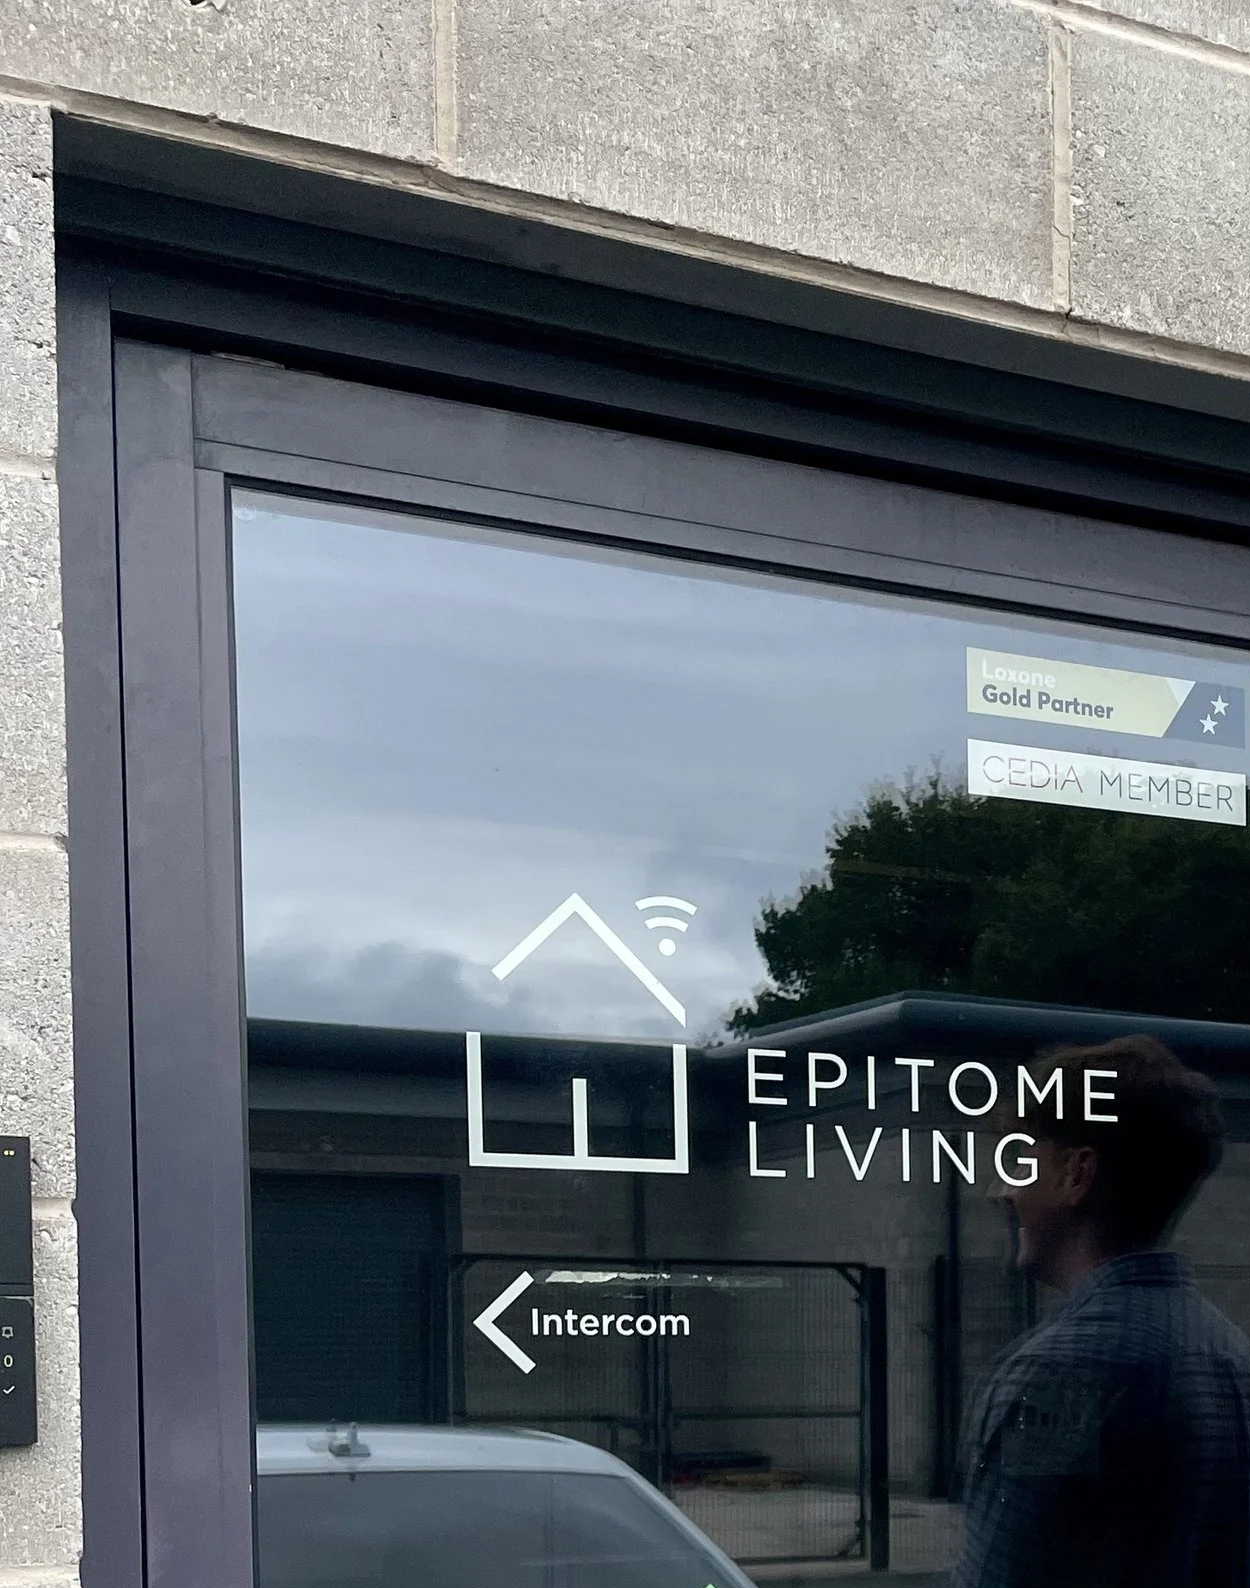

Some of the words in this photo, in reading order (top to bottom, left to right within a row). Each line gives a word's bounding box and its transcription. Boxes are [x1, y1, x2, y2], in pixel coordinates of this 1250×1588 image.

[981, 659, 1056, 688] Loxone
[982, 684, 1031, 709] Gold
[1037, 692, 1114, 719] Partner
[982, 755, 1083, 793] CEDIA
[1100, 769, 1233, 812] MEMBER
[748, 1048, 1118, 1122] EPITOME
[749, 1120, 1040, 1187] LIVING
[531, 1307, 691, 1337] Intercom
